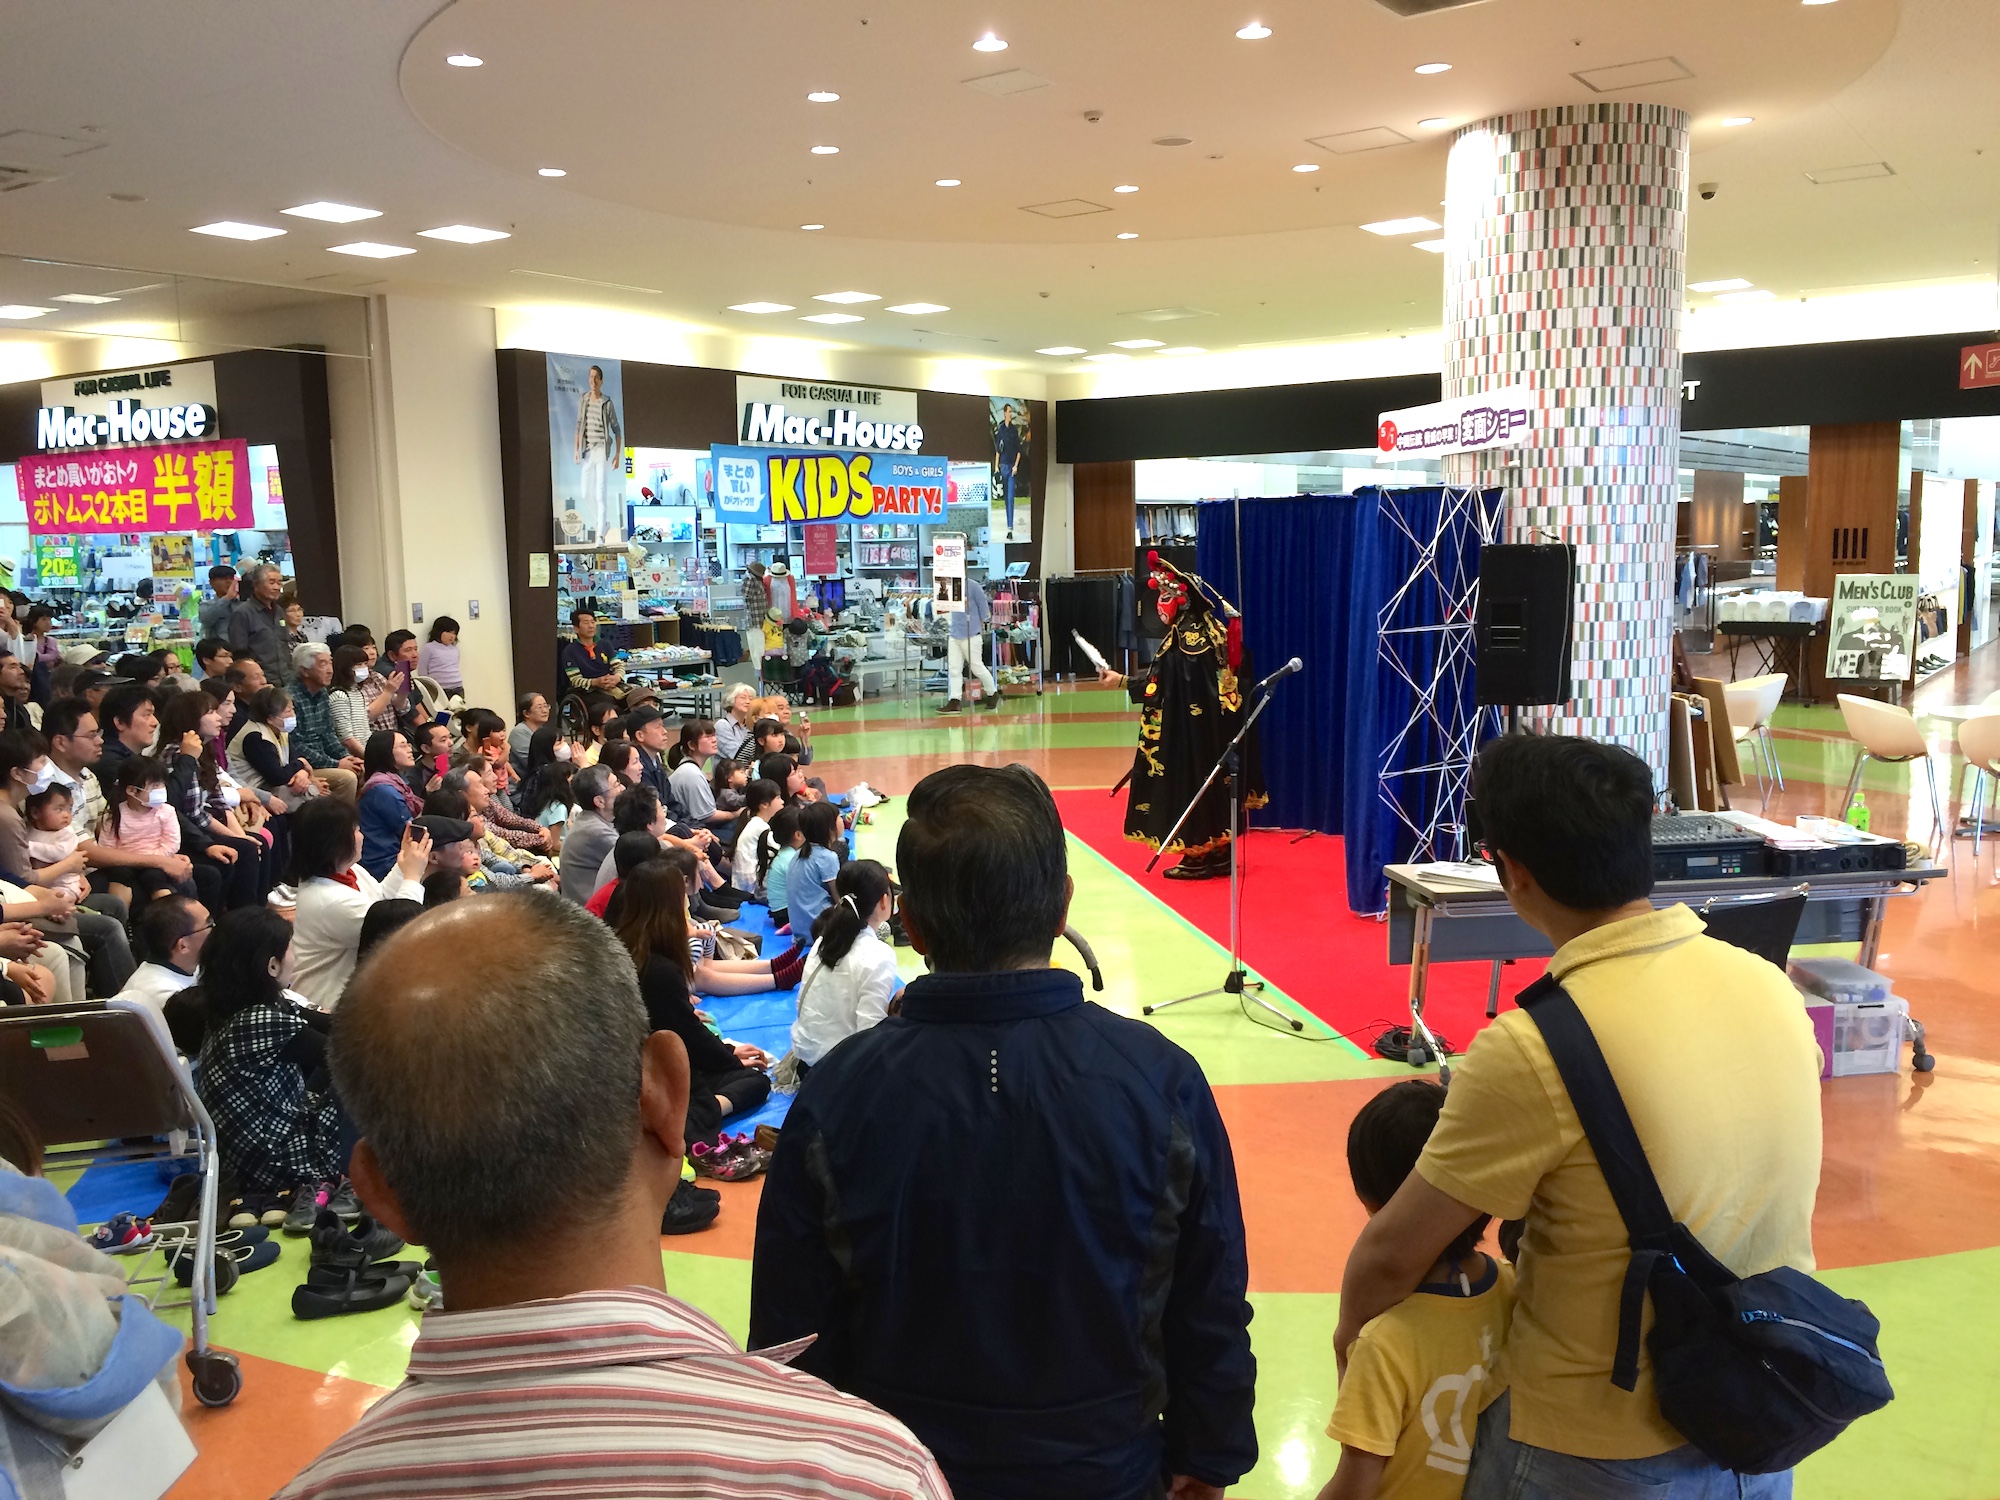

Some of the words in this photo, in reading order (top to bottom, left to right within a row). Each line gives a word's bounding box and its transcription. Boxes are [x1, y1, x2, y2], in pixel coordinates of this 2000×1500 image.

[74, 380, 98, 397] FOR
[99, 374, 145, 393] CASUAL
[144, 370, 172, 388] LIFE
[781, 383, 806, 399] FOR
[809, 387, 856, 403] CASUAL
[857, 390, 882, 406] LIFE
[37, 398, 208, 450] Mac-House
[747, 402, 924, 450] Mac-House
[1461, 407, 1527, 446] 変面ショー
[34, 459, 139, 489] まとめ買いがおトク
[723, 464, 755, 479] まとめ
[730, 479, 750, 493] 買い
[892, 464, 914, 476] BOYS
[921, 465, 944, 478] GIRLS
[153, 450, 237, 524] 半額
[768, 453, 874, 523] KIDS
[873, 485, 942, 515] PARTY!
[33, 488, 148, 526] ボトムス2本目
[40, 558, 77, 577] 20%
